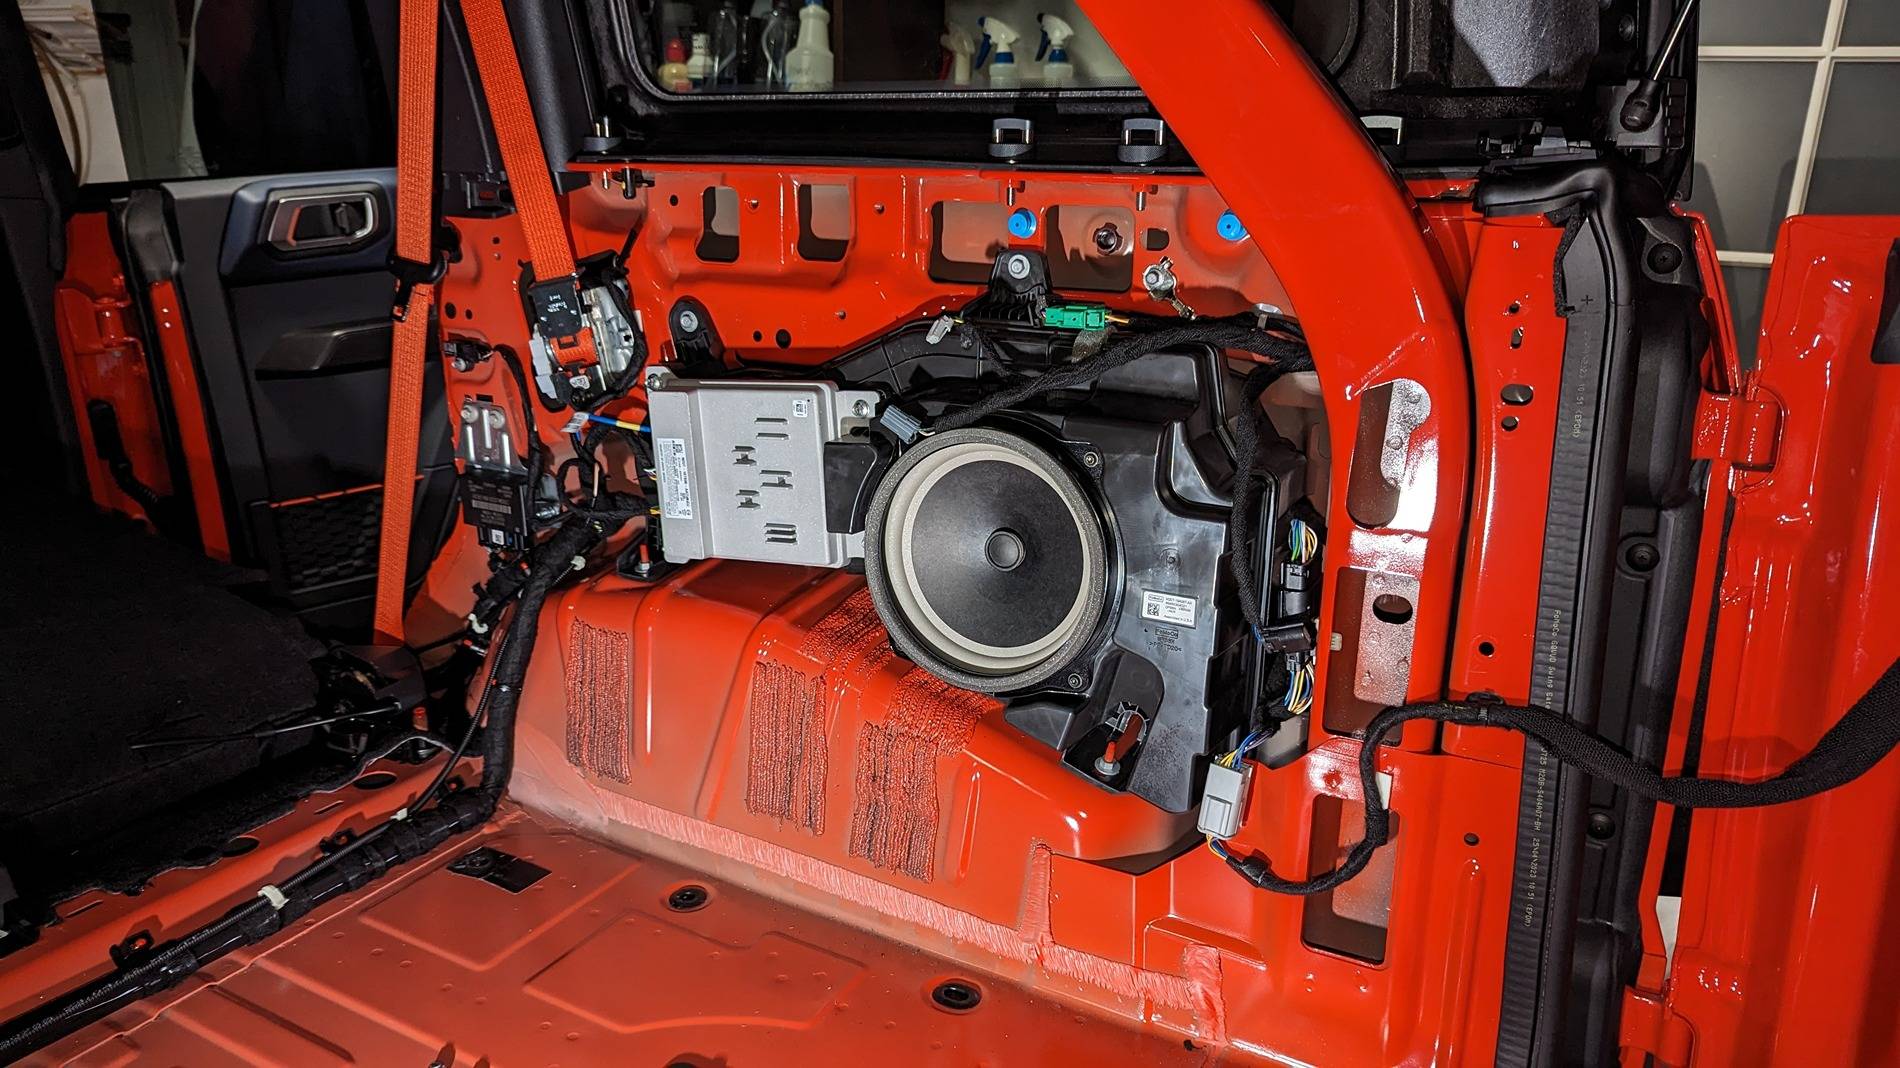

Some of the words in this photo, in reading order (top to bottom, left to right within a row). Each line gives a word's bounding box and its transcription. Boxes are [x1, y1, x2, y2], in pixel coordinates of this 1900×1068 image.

[1552, 609, 1562, 637] FoMoCo
[1546, 666, 1556, 688] Swing
[1544, 692, 1554, 710] Gate
